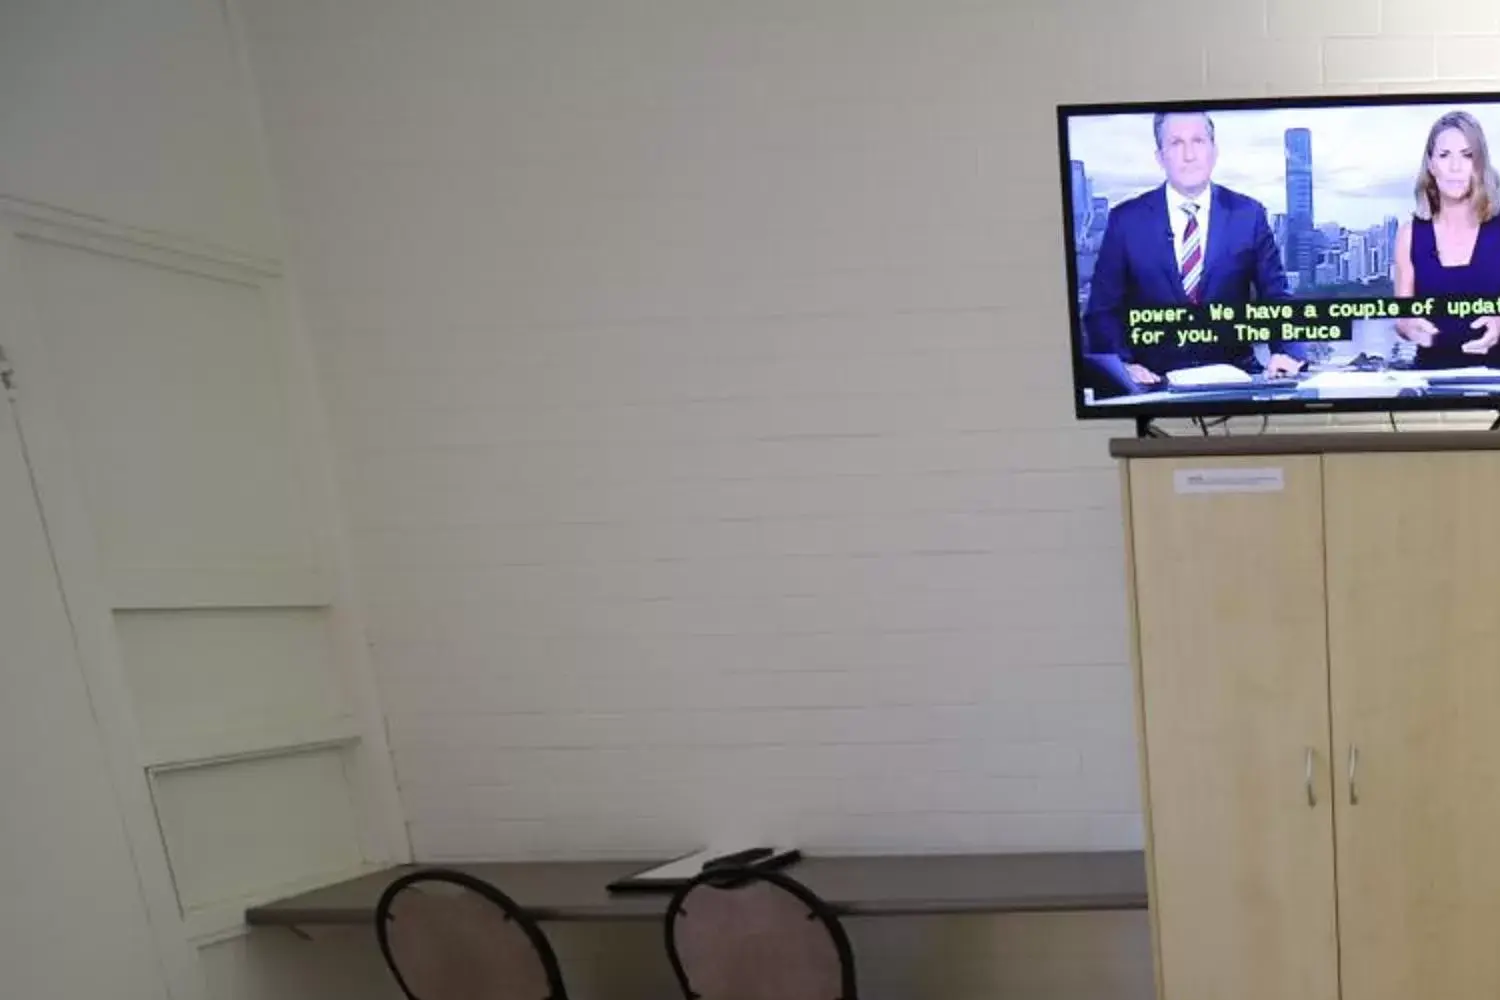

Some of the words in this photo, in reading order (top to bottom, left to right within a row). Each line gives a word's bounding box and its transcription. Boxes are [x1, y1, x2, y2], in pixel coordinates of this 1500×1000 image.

[1129, 308, 1194, 326] power.
[1210, 303, 1234, 320] We
[1246, 303, 1293, 319] have
[1304, 304, 1317, 318] a
[1329, 300, 1399, 320] couple
[1411, 298, 1434, 315] of
[1131, 327, 1164, 344] for
[1177, 329, 1218, 347] you.
[1234, 324, 1270, 341] The
[1281, 323, 1341, 340] Bruce
